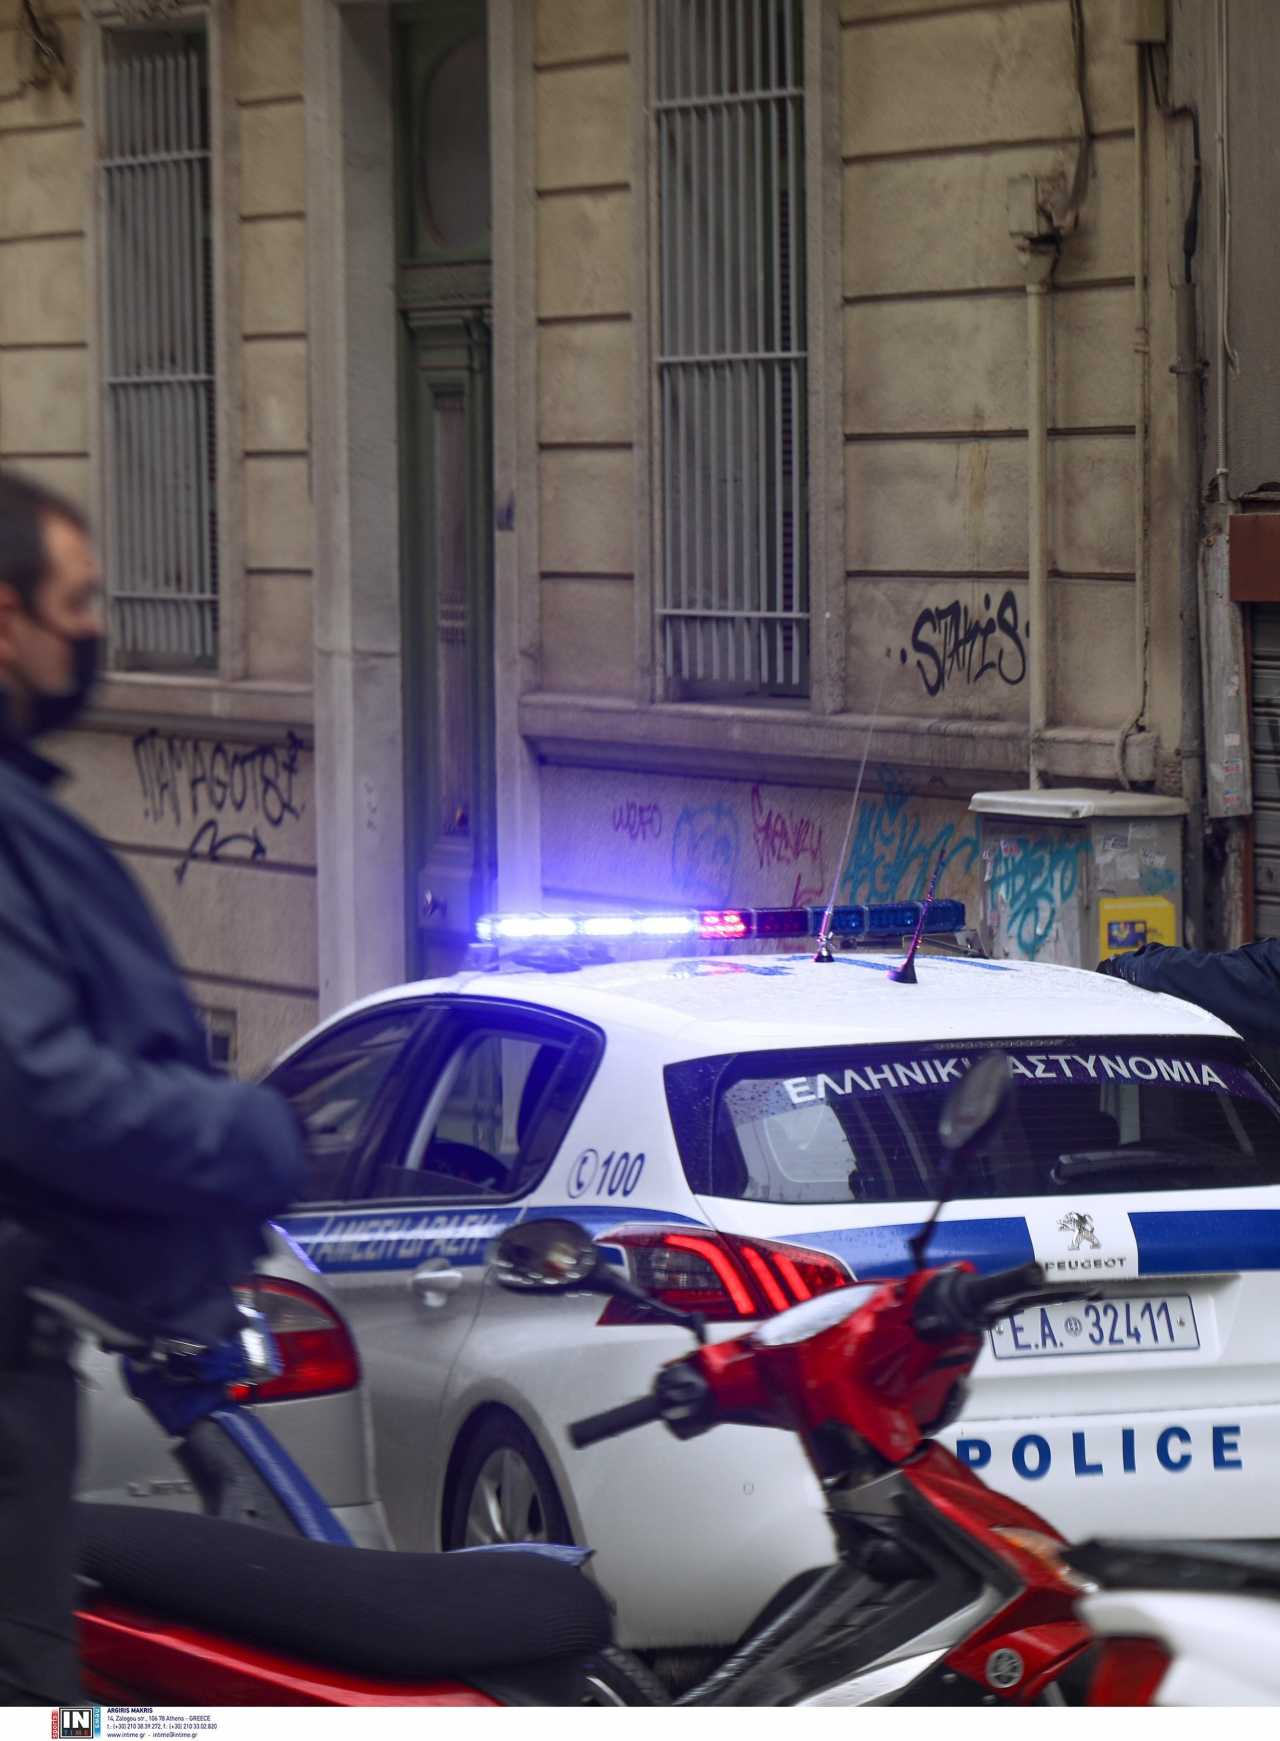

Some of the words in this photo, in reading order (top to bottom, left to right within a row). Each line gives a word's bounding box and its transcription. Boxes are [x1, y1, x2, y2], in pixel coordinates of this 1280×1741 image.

[783, 1055, 972, 1105] ΕΛΛΗΝΙΚ
[1006, 1054, 1230, 1090] ΑΣΤΥΝΟΜΙΑ
[596, 1150, 646, 1198] 100
[1043, 1256, 1127, 1272] PEUGEOT
[1083, 1300, 1175, 1346] 32411
[955, 1425, 1243, 1481] POLICE
